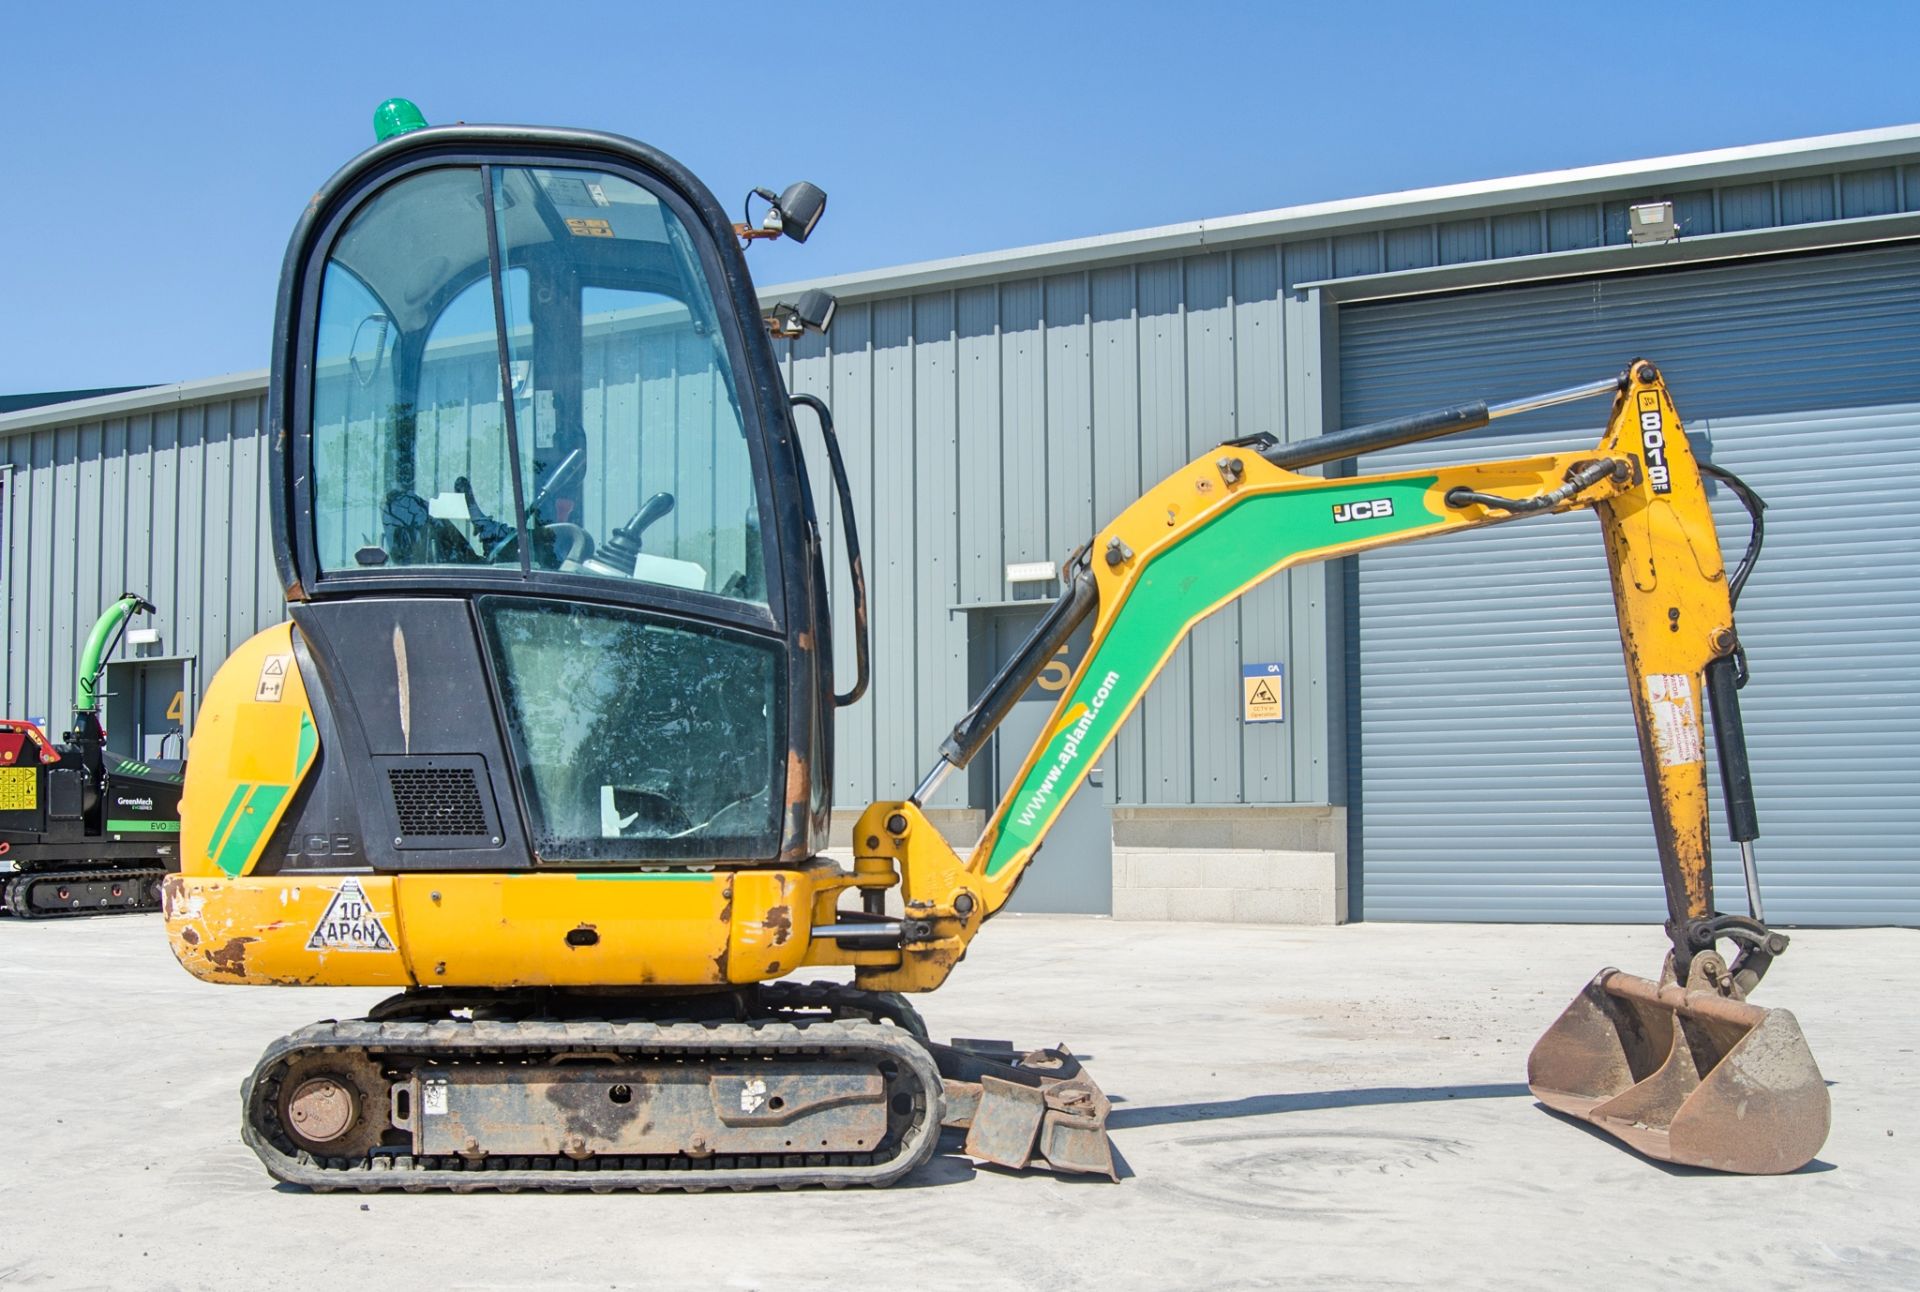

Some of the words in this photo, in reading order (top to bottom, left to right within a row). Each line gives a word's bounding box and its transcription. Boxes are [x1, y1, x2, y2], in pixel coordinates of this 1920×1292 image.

[1641, 412, 1668, 484] 8018
[1333, 499, 1393, 522] JCB
[1018, 670, 1120, 827] www.aplant.com
[117, 797, 153, 805] GreenMech
[150, 822, 166, 830] EVO
[340, 902, 361, 921] 10
[327, 922, 375, 942] AP6N
